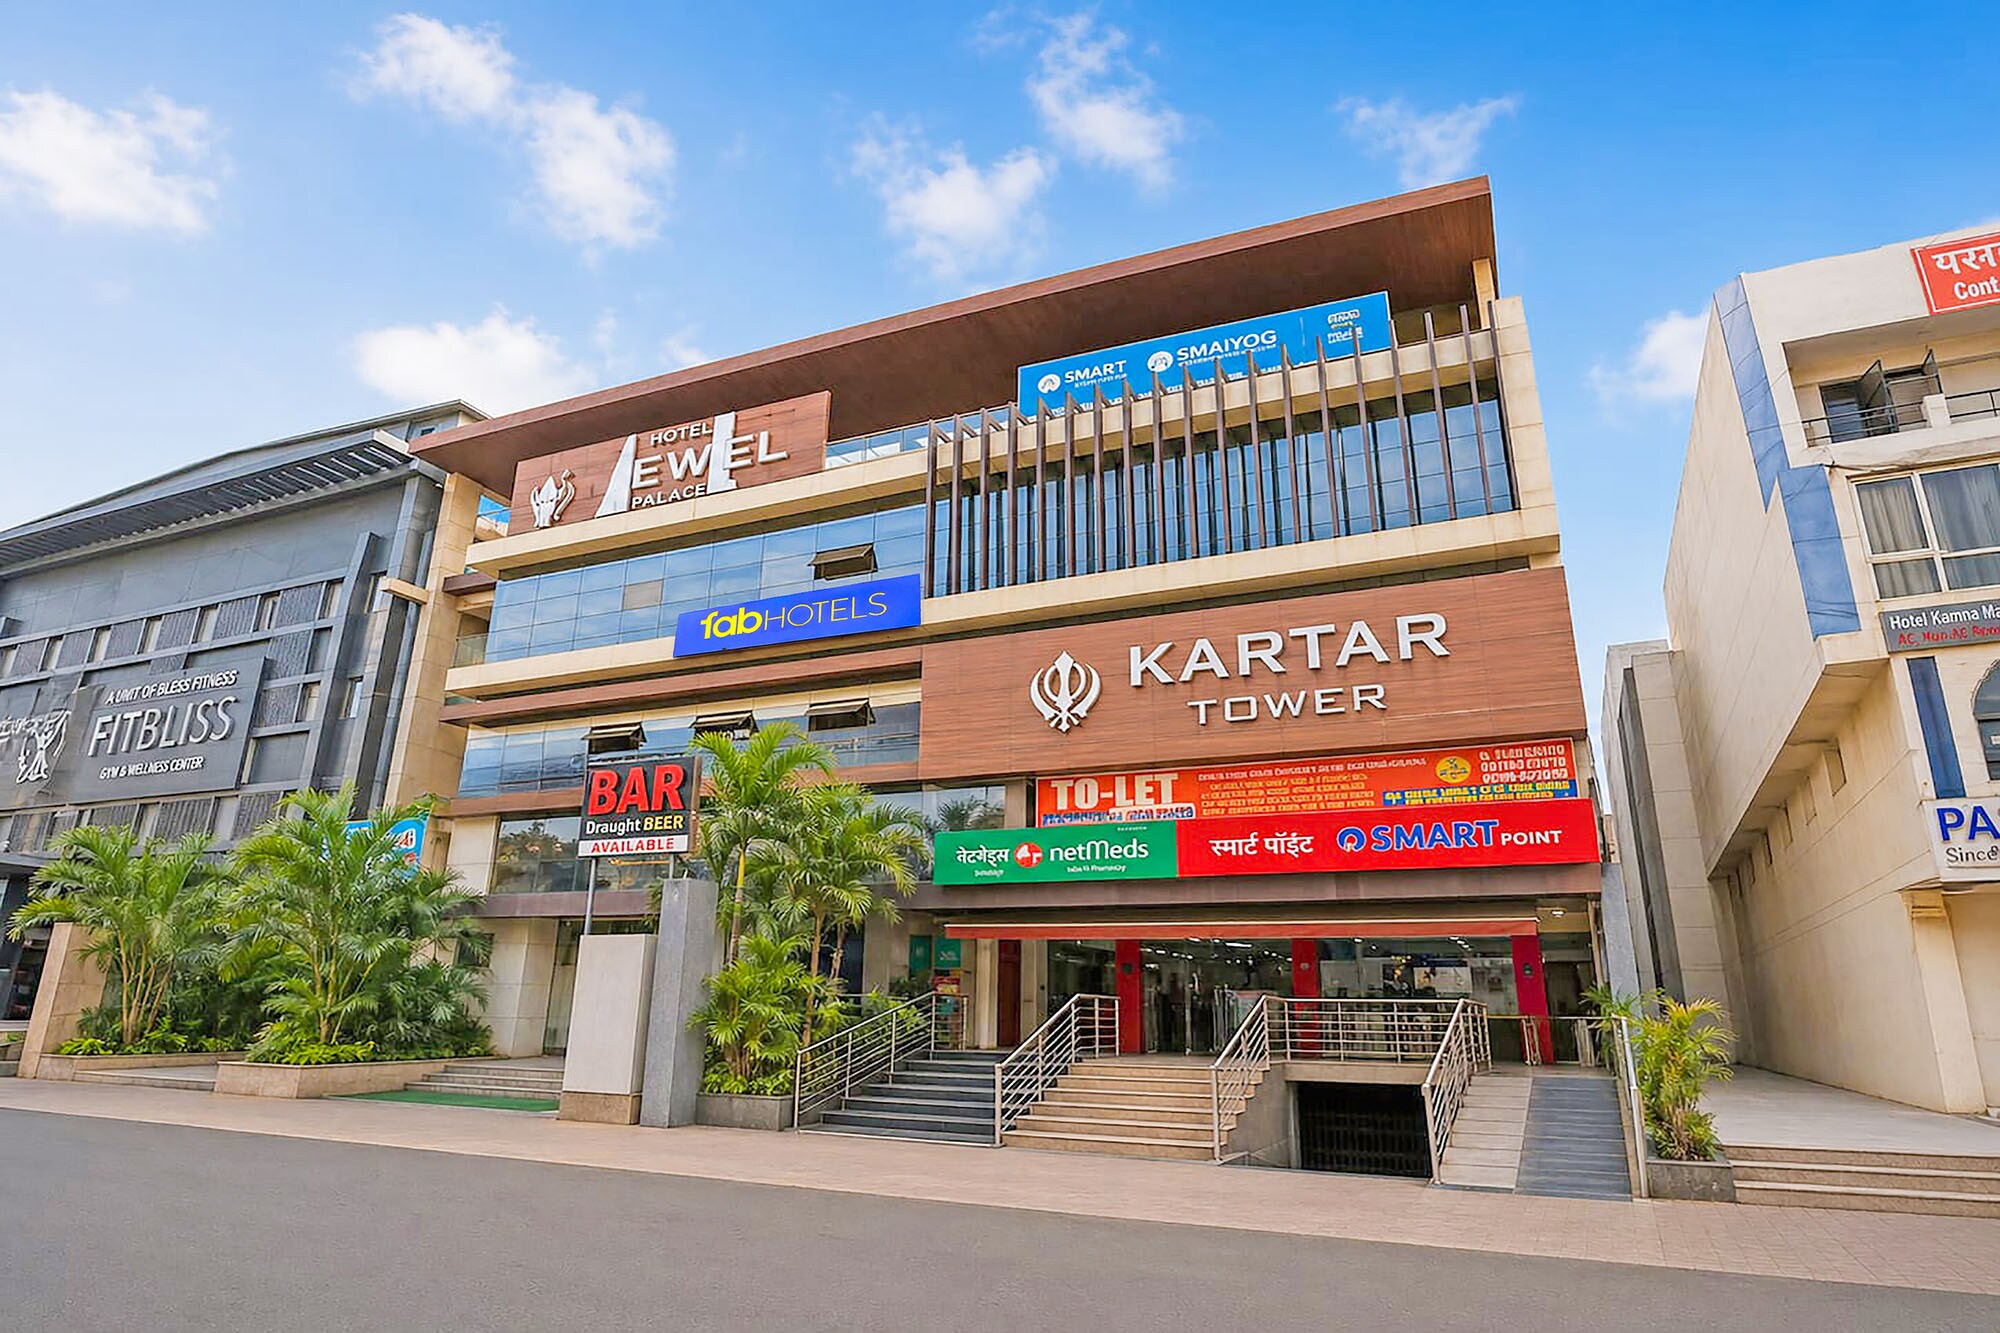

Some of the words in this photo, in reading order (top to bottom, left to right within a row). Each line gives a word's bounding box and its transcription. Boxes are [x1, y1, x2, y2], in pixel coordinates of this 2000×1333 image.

[1064, 360, 1127, 383] SMART
[651, 422, 712, 446] HOTEL
[631, 484, 706, 509] PALACE
[1889, 612, 1928, 629] Hotel
[1931, 609, 1979, 625] Kamna
[1129, 612, 1450, 687] KARTAR
[142, 685, 158, 699] OF
[157, 678, 191, 696] BLESS
[191, 670, 238, 691] FITNESS
[1187, 684, 1387, 725] TOWER
[88, 697, 237, 756] FITBLISS
[170, 756, 205, 770] CENTER
[587, 764, 684, 816] BAR
[1051, 773, 1178, 810] TO-LET
[586, 819, 641, 836] Draught
[643, 815, 684, 831] BEER
[1370, 819, 1499, 852] SMART
[1501, 830, 1563, 846] POINT
[591, 838, 675, 853] AVAILABLE
[1208, 832, 1259, 856] स्मार्ट
